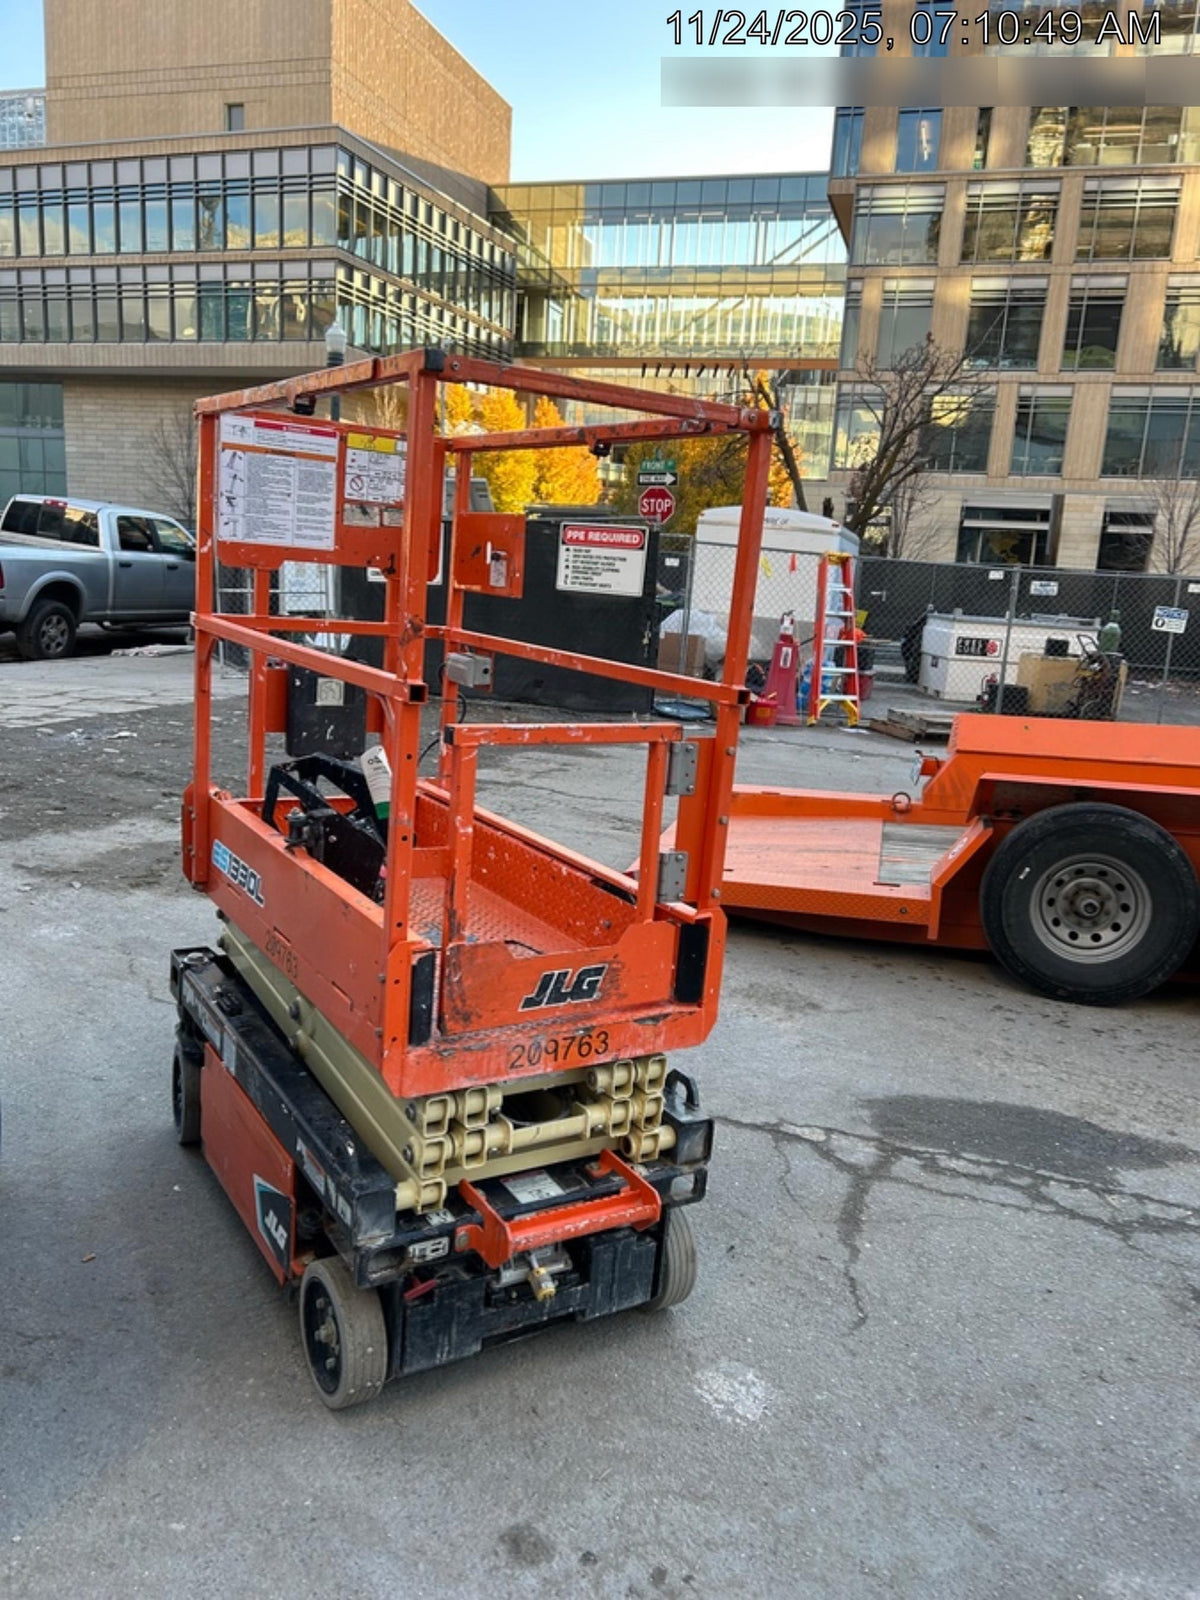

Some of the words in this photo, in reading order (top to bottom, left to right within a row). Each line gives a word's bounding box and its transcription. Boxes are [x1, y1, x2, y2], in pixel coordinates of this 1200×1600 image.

[642, 499, 673, 513] STOP
[566, 530, 586, 541] PPE
[588, 531, 640, 544] REQUIRED
[518, 963, 609, 1012] JLG
[508, 1031, 610, 1070] 209763
[264, 1209, 288, 1250] JLG
